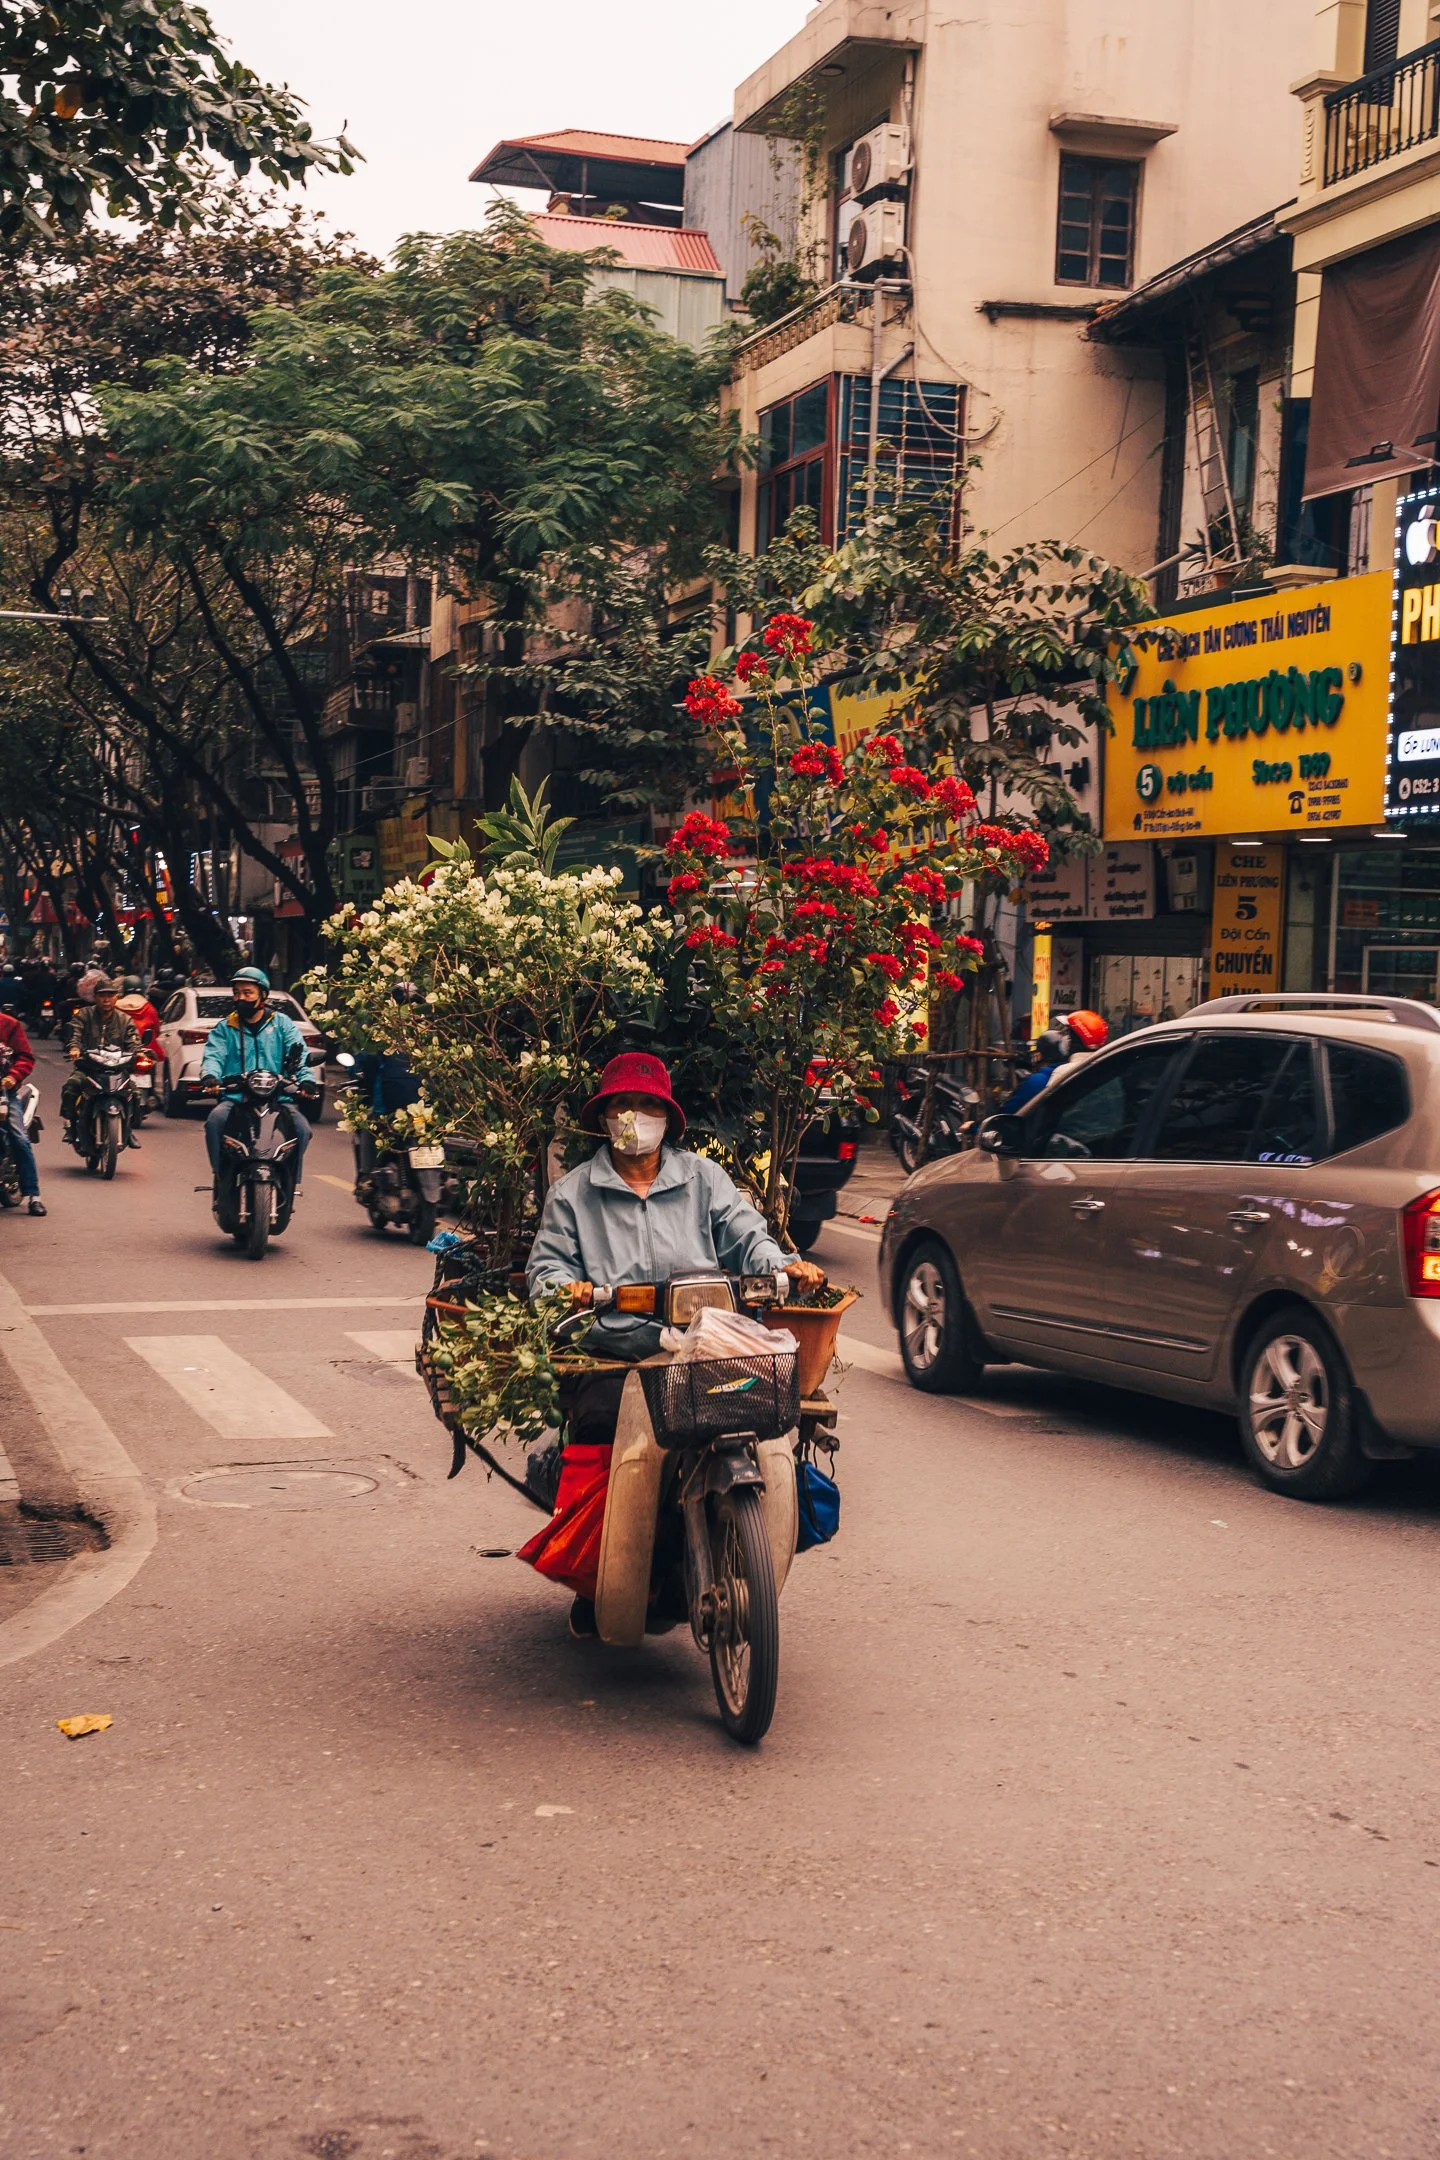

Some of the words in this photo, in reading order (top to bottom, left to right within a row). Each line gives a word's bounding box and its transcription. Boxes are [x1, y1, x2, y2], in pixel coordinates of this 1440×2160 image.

[1132, 679, 1201, 748] LIÊN
[1205, 666, 1345, 740] PHƯƠNG
[1141, 768, 1153, 797] 5
[1252, 758, 1293, 786] Since
[1235, 894, 1257, 920] 5
